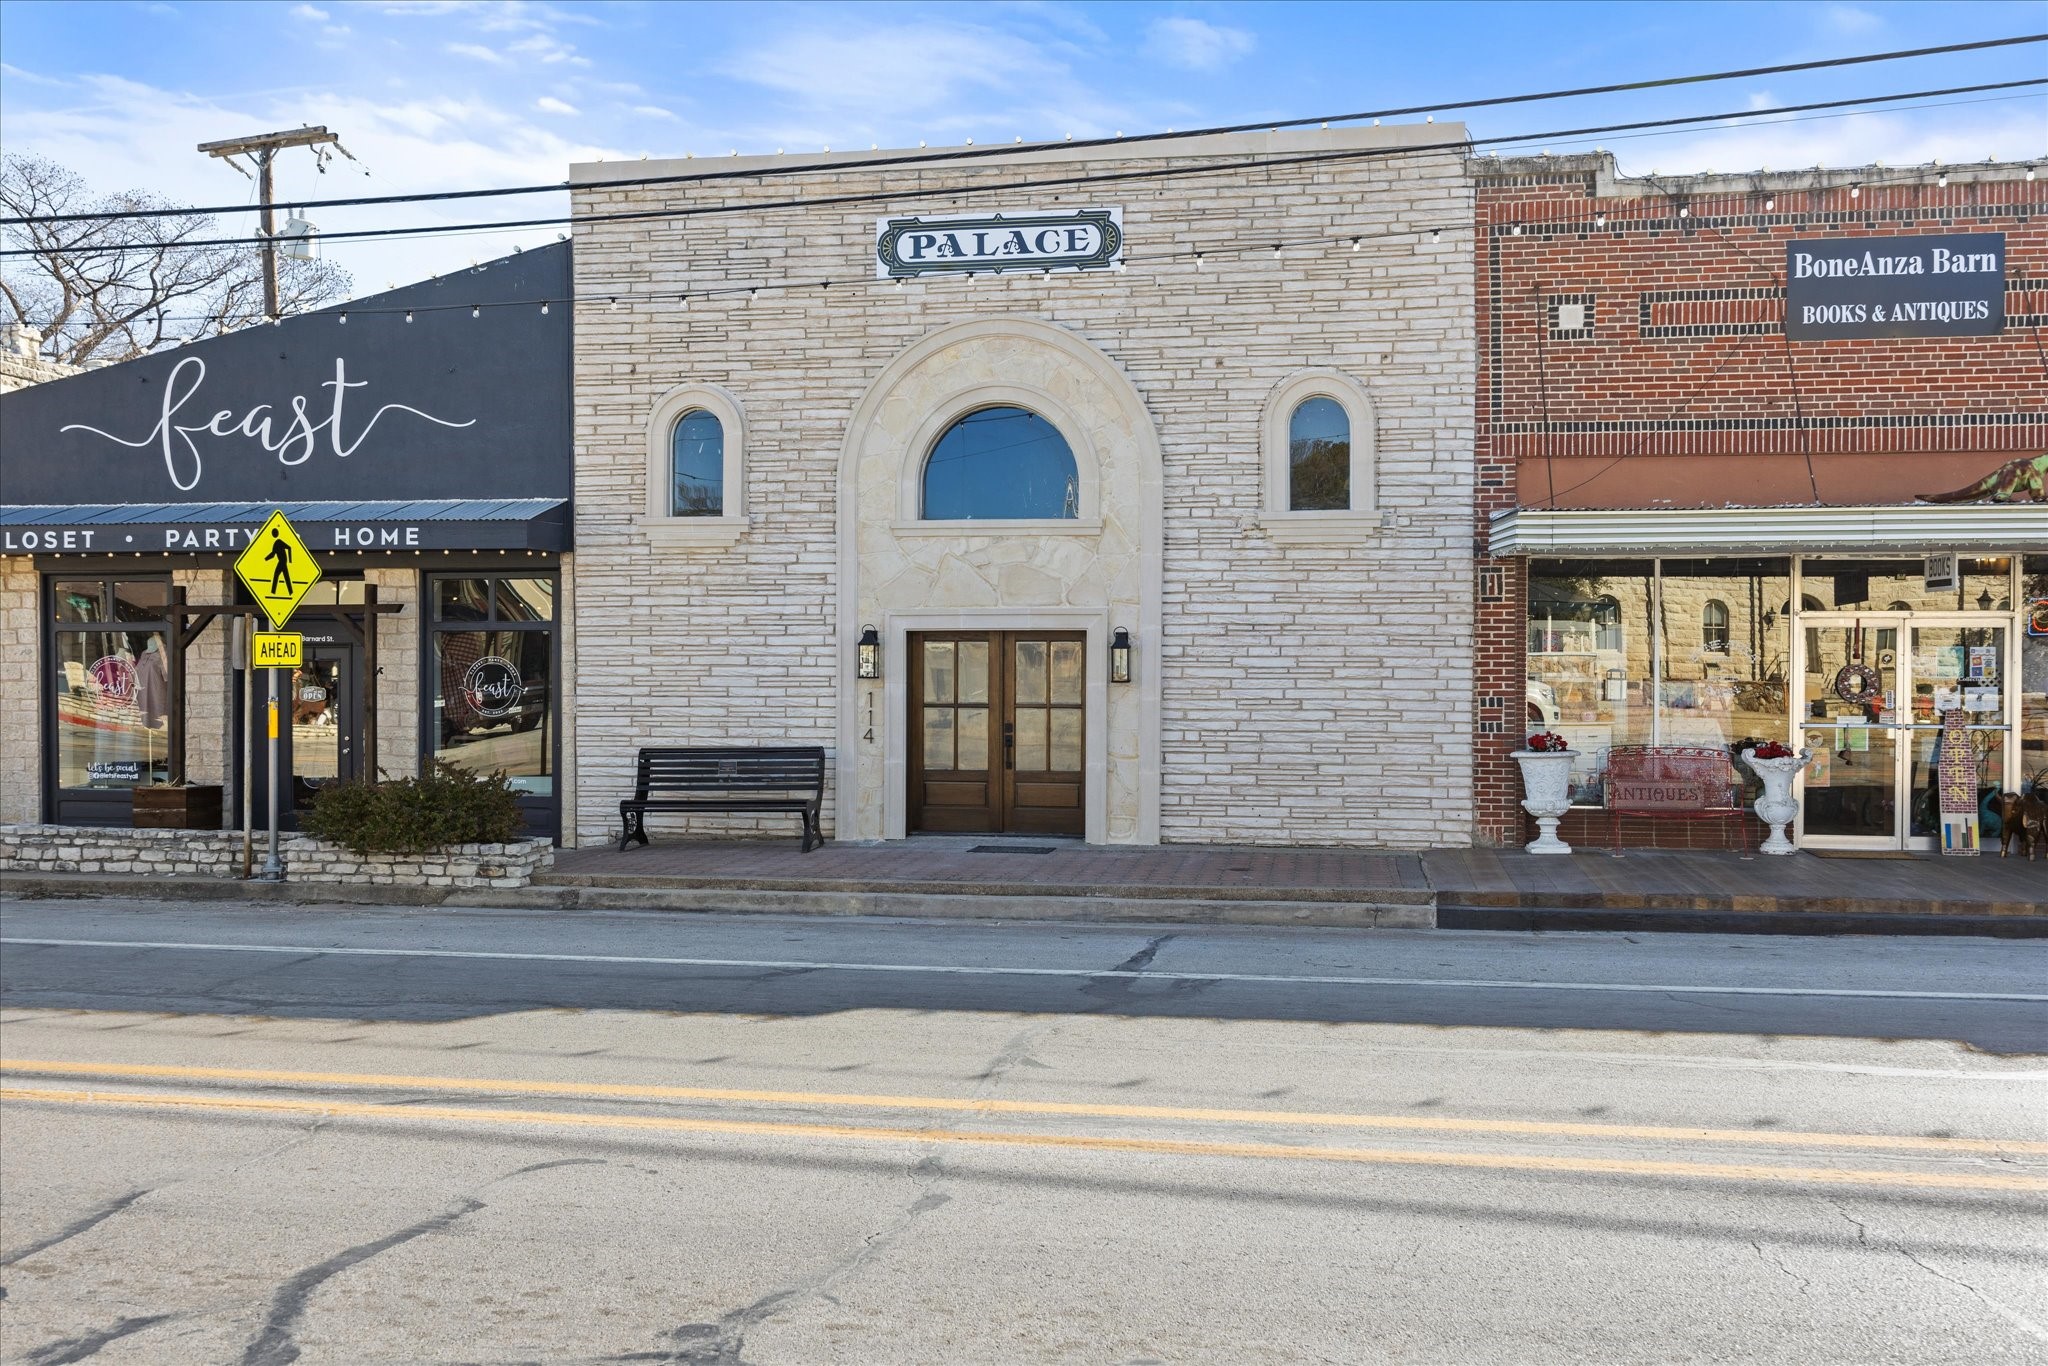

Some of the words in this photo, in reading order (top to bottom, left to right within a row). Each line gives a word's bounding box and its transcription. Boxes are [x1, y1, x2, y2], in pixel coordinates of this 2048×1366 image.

[908, 227, 1090, 259] PALACE
[1794, 250, 1925, 279] BoneAnza
[1931, 248, 1998, 275] Barn
[1802, 304, 1867, 325] BOOKS
[1871, 304, 1887, 323] &
[1890, 300, 1989, 323] ANTIQUES
[62, 356, 476, 490] feast
[165, 527, 260, 547] PARTY
[334, 527, 420, 546] HOME
[1928, 557, 1951, 578] BOOKS
[261, 642, 297, 658] AHEAD
[303, 692, 322, 700] OPEN
[460, 671, 524, 704] feast
[863, 691, 875, 744] 114
[116, 762, 139, 773] social
[1949, 729, 1968, 802] OPEN
